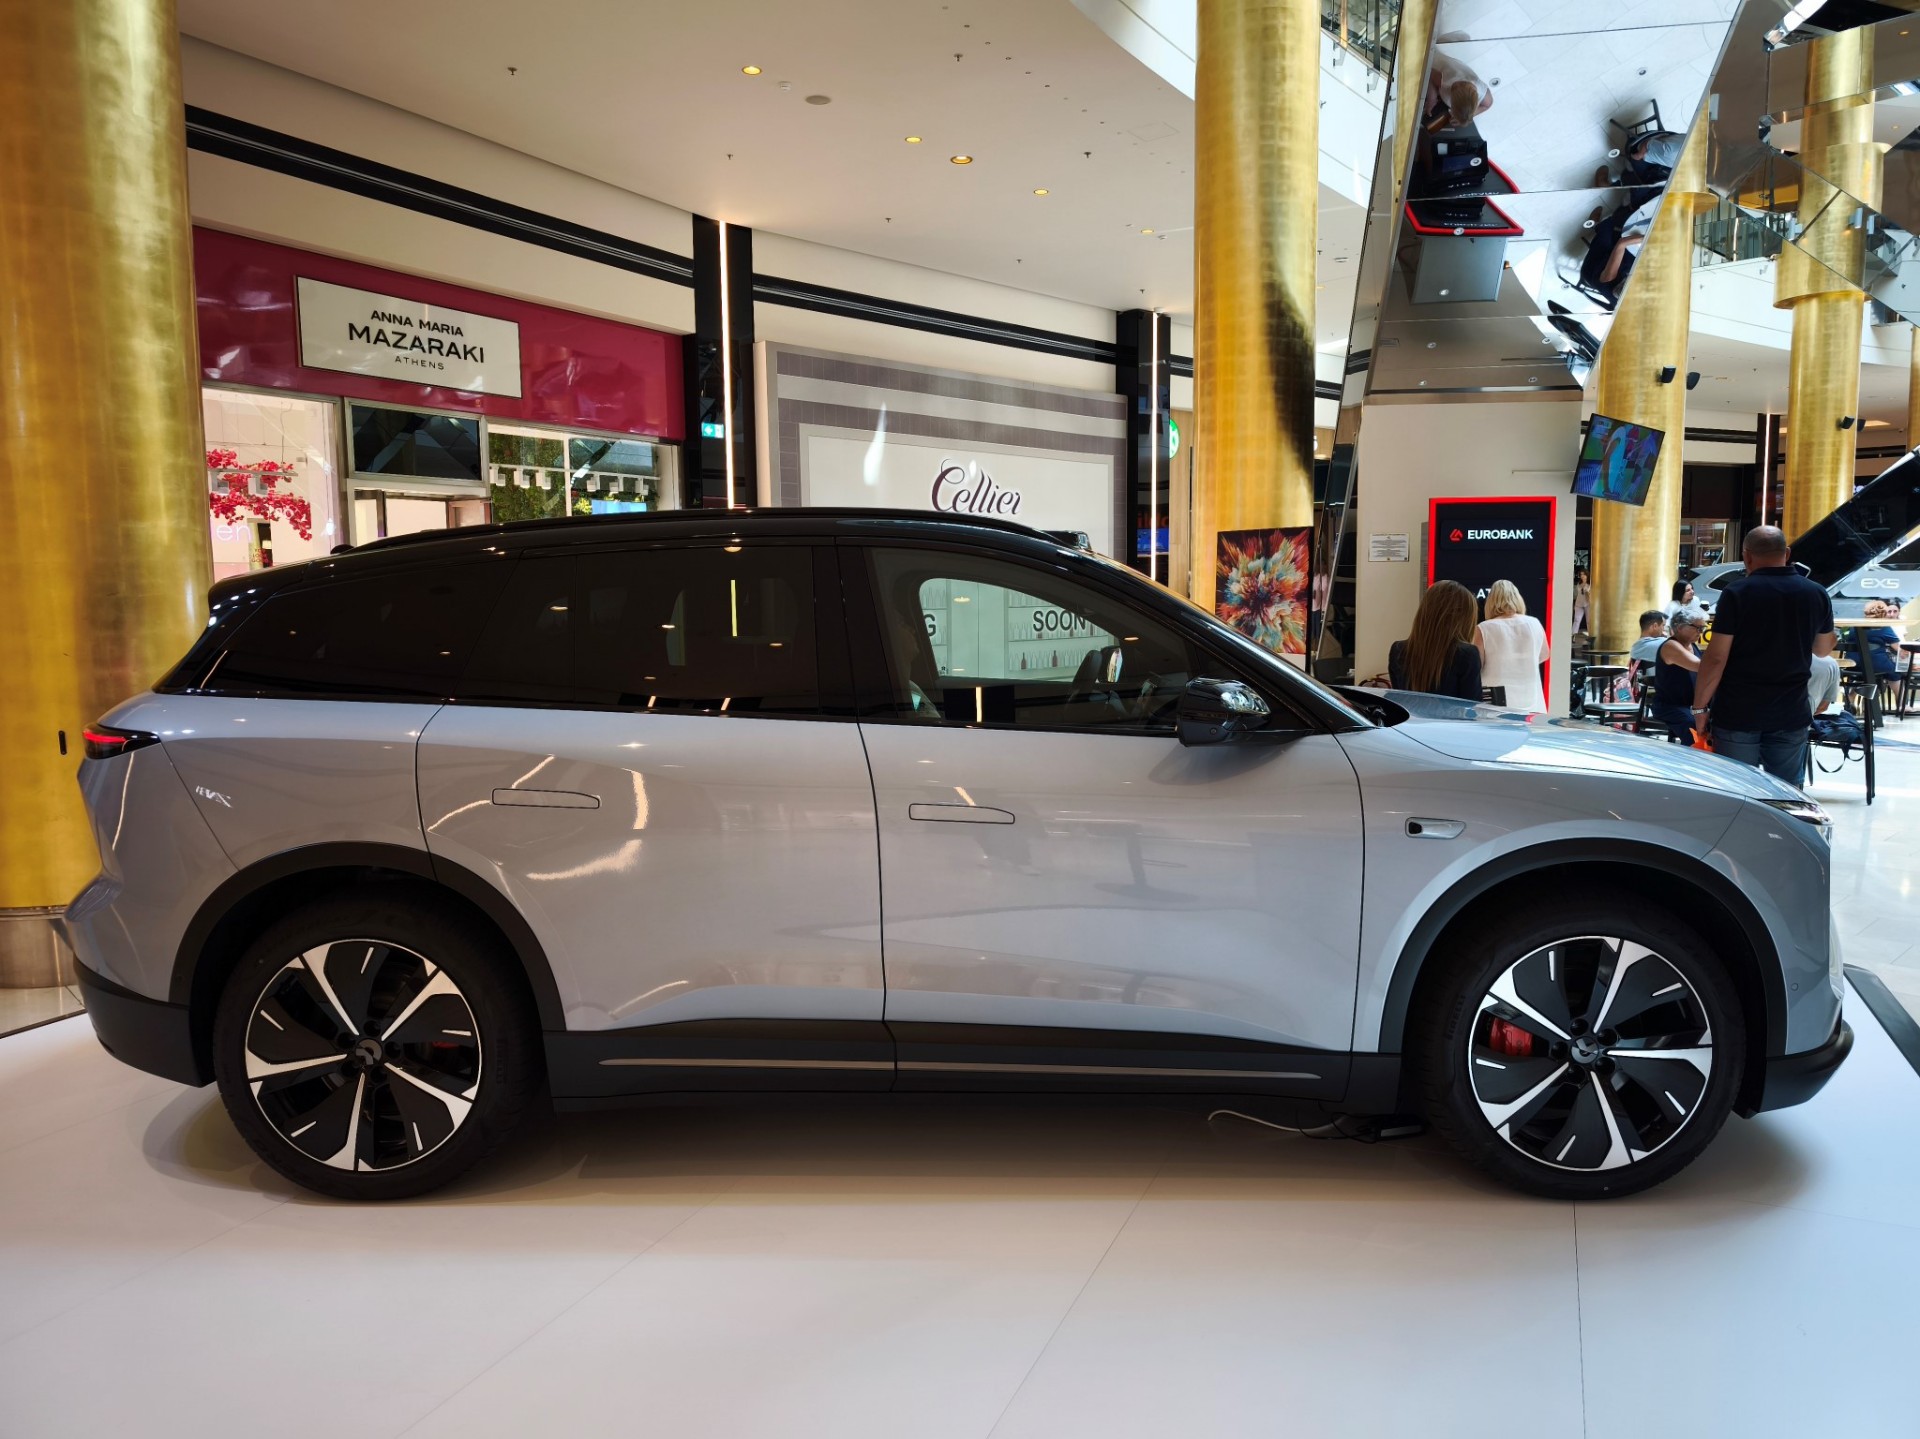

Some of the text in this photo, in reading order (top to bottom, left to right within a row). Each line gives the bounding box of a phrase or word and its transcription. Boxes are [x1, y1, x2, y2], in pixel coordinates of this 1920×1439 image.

[371, 310, 463, 337] ANNA MARIA
[348, 323, 485, 363] MAZARAKI
[395, 356, 445, 370] ATHENS
[931, 458, 1021, 515] Cellier
[1467, 529, 1533, 540] EUROBANK
[1860, 578, 1900, 589] EX5
[1033, 610, 1086, 632] SOON
